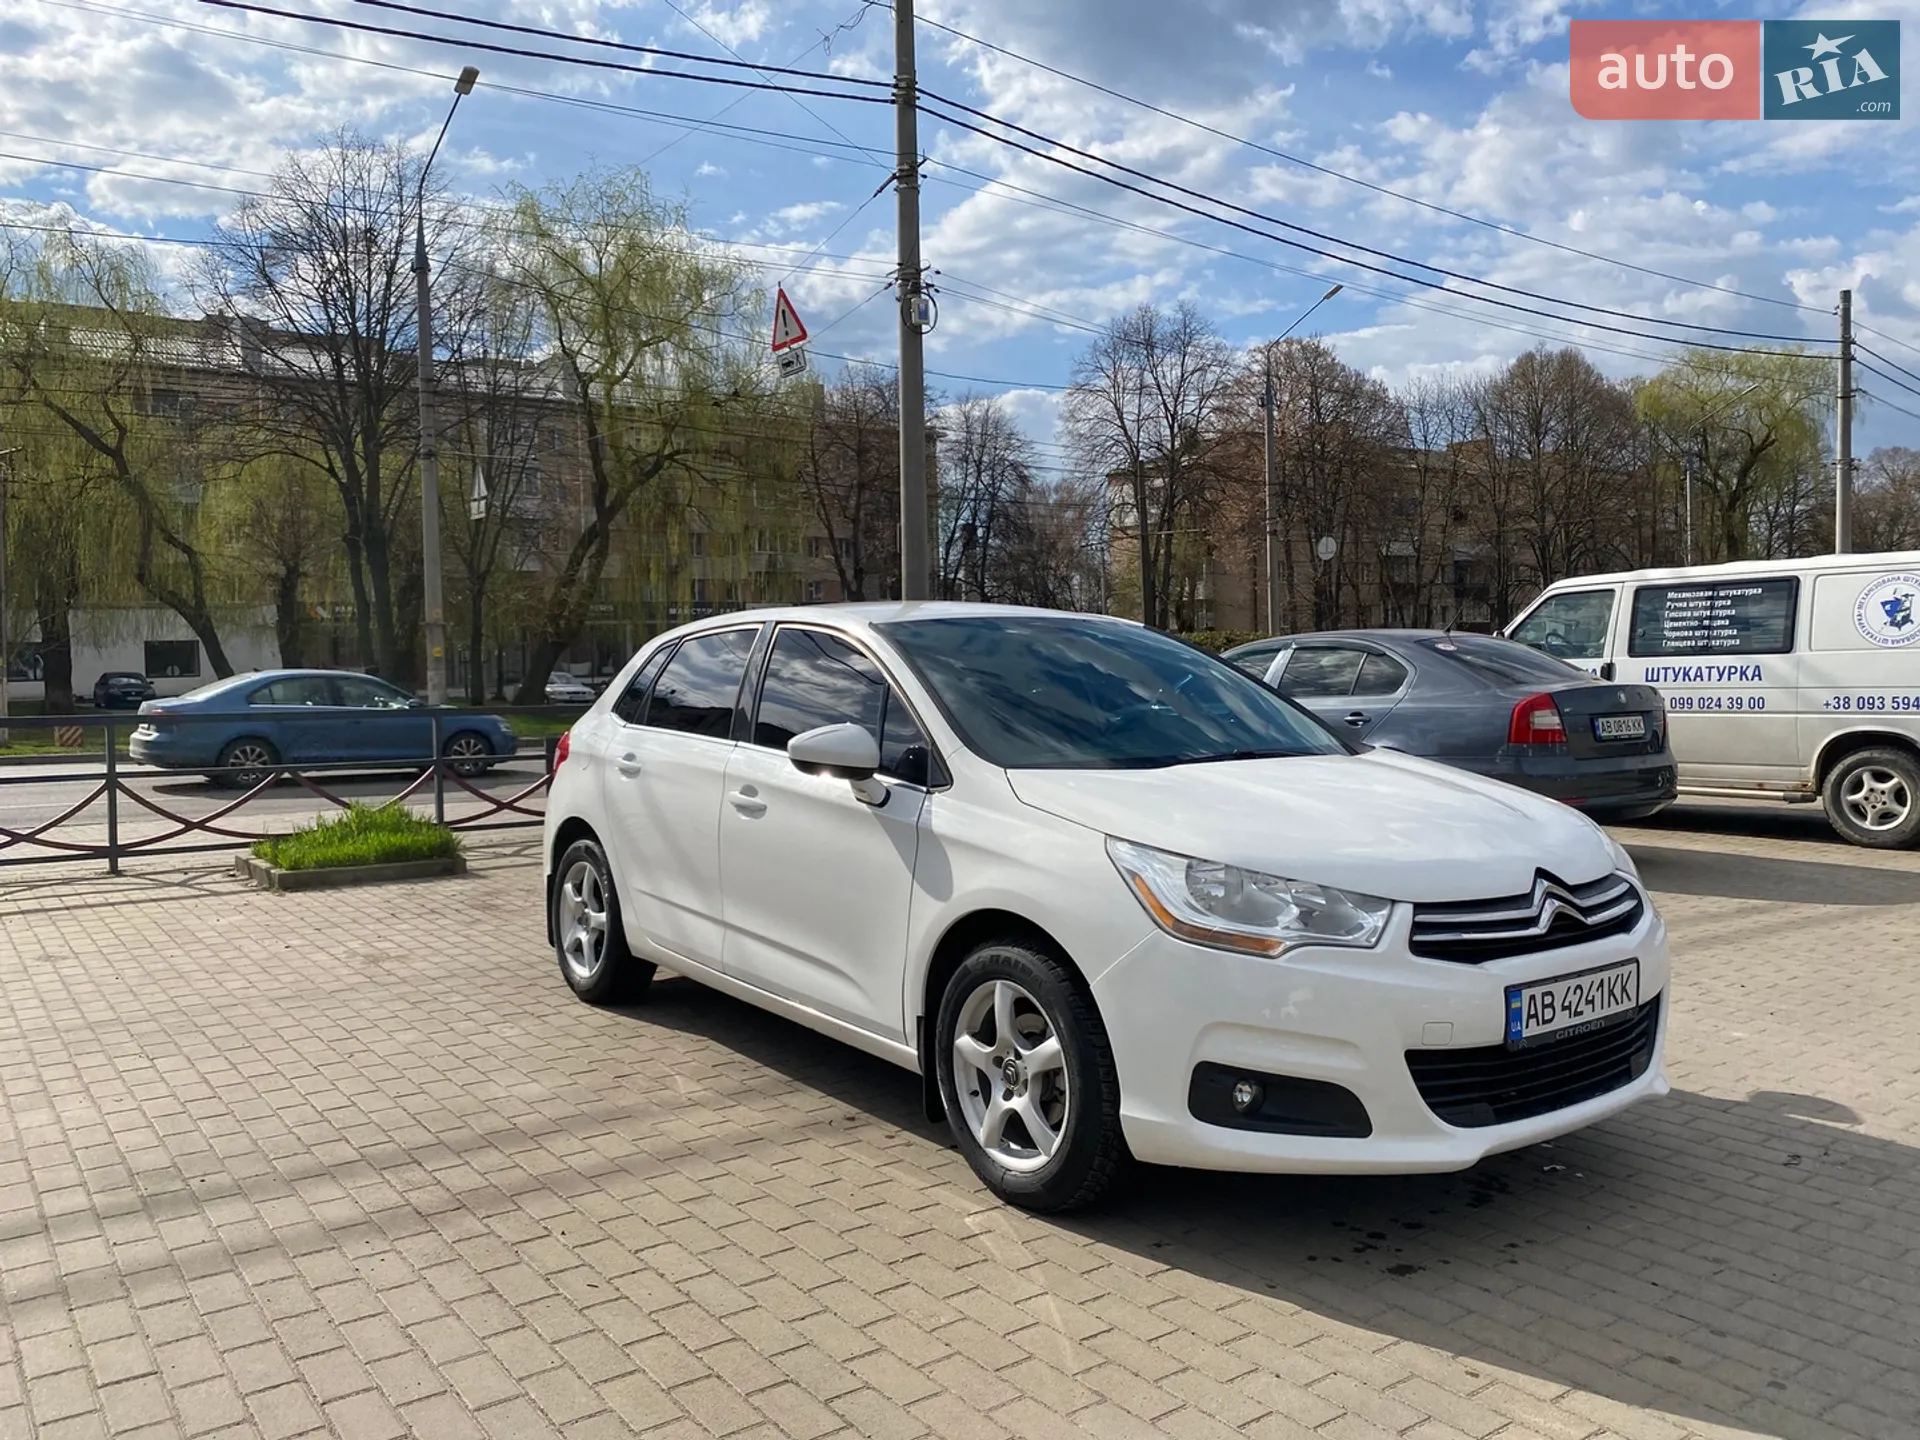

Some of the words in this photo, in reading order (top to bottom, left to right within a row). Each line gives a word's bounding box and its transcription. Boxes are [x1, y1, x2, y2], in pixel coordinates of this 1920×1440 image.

[1689, 600, 1731, 608] штукаурка
[1645, 665, 1763, 682] ШТУКАТУРКА
[1670, 697, 1694, 710] 099
[1698, 697, 1722, 710] 024
[1727, 696, 1744, 710] 39
[1748, 696, 1765, 710] 00
[1823, 696, 1851, 710] +38
[1857, 696, 1885, 710] 093
[1891, 696, 1920, 710] 594
[1526, 990, 1556, 1029] AB
[1511, 1021, 1521, 1032] UA
